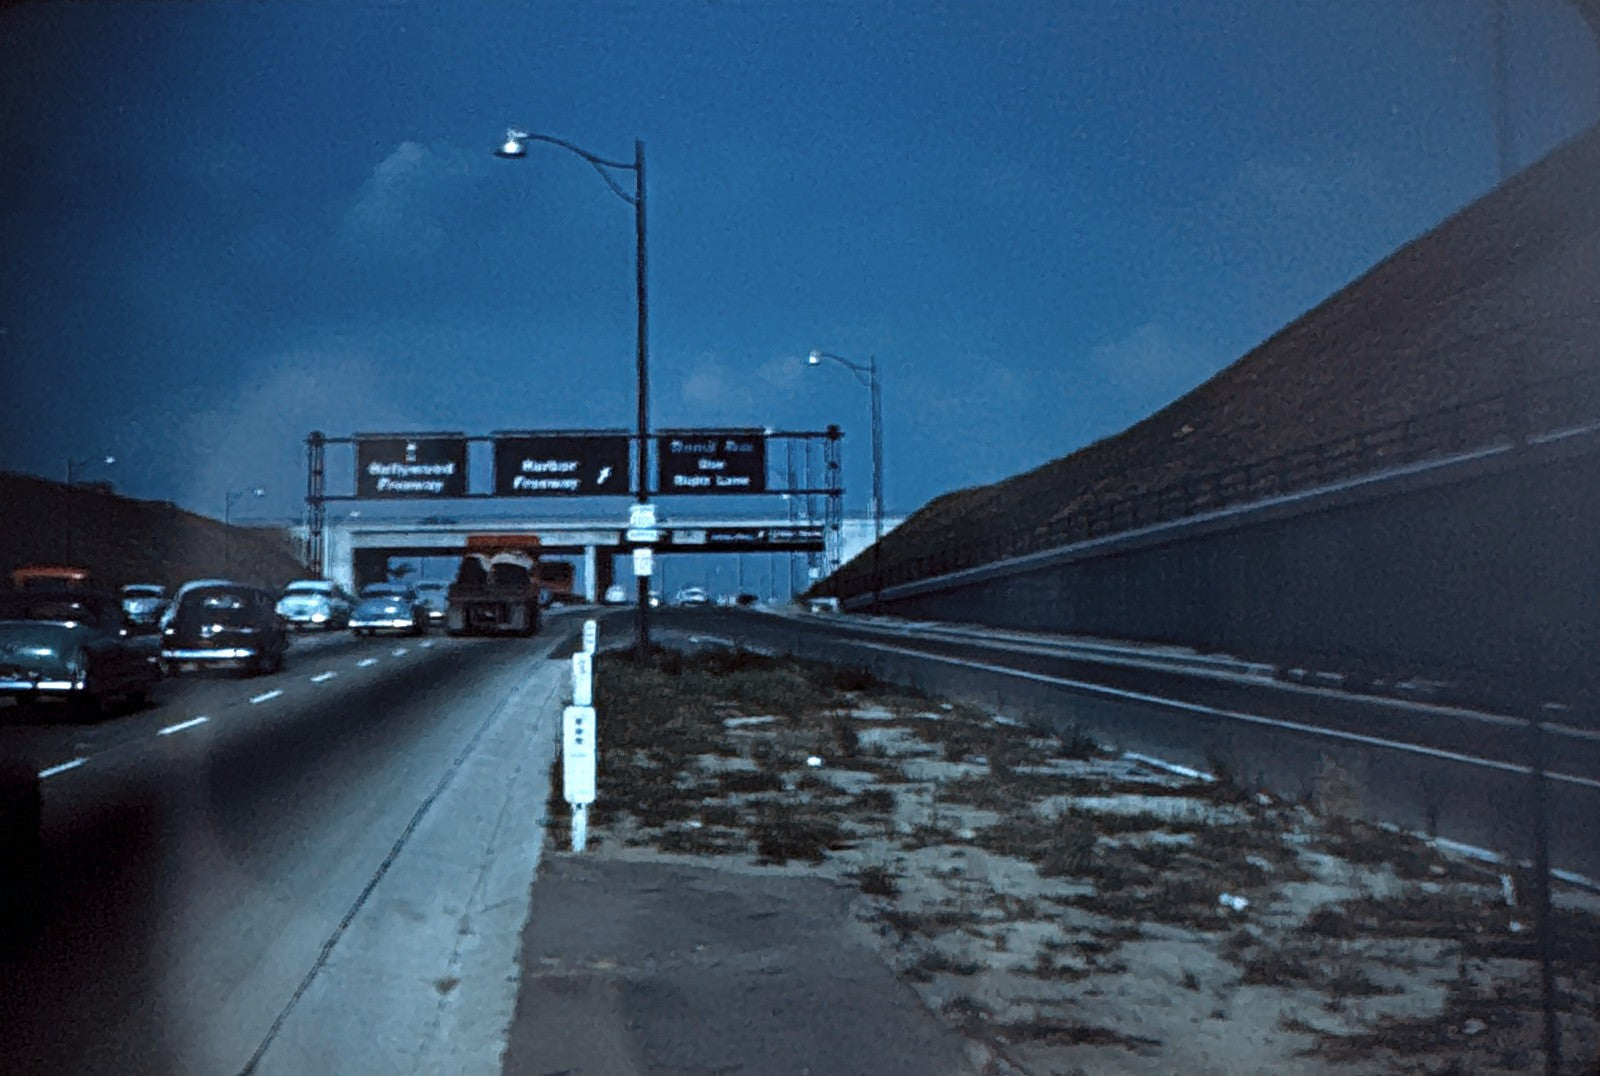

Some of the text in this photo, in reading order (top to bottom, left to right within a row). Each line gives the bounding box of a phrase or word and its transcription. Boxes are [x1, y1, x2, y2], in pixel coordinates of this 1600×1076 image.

[522, 459, 579, 472] Harbor
[376, 478, 445, 492] Freeway
[513, 475, 580, 490] Freeway
[673, 474, 750, 487] Right Lane
